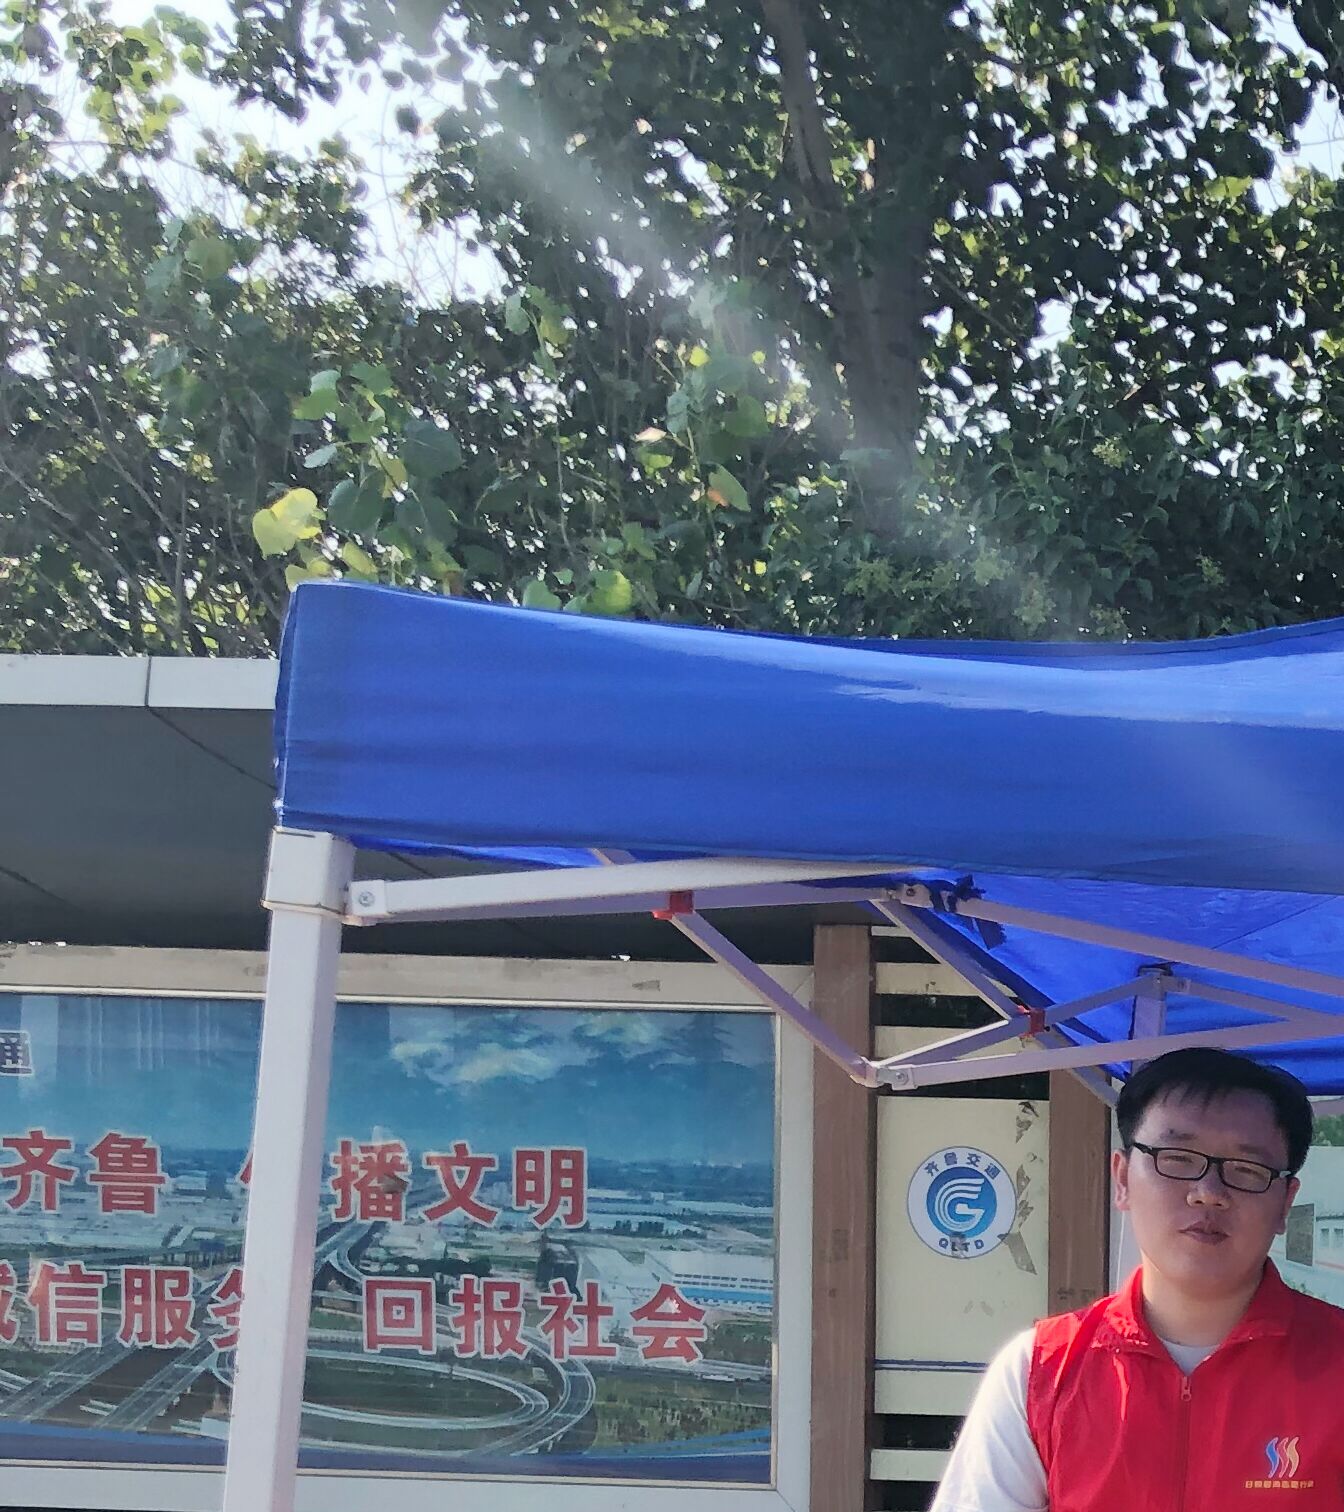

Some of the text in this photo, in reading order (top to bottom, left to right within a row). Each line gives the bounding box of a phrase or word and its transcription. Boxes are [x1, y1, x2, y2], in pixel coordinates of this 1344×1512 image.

[239, 1140, 587, 1228] 播文明
[924, 1152, 1000, 1180] 齐鲁交通
[363, 1275, 708, 1363] 回报社会
